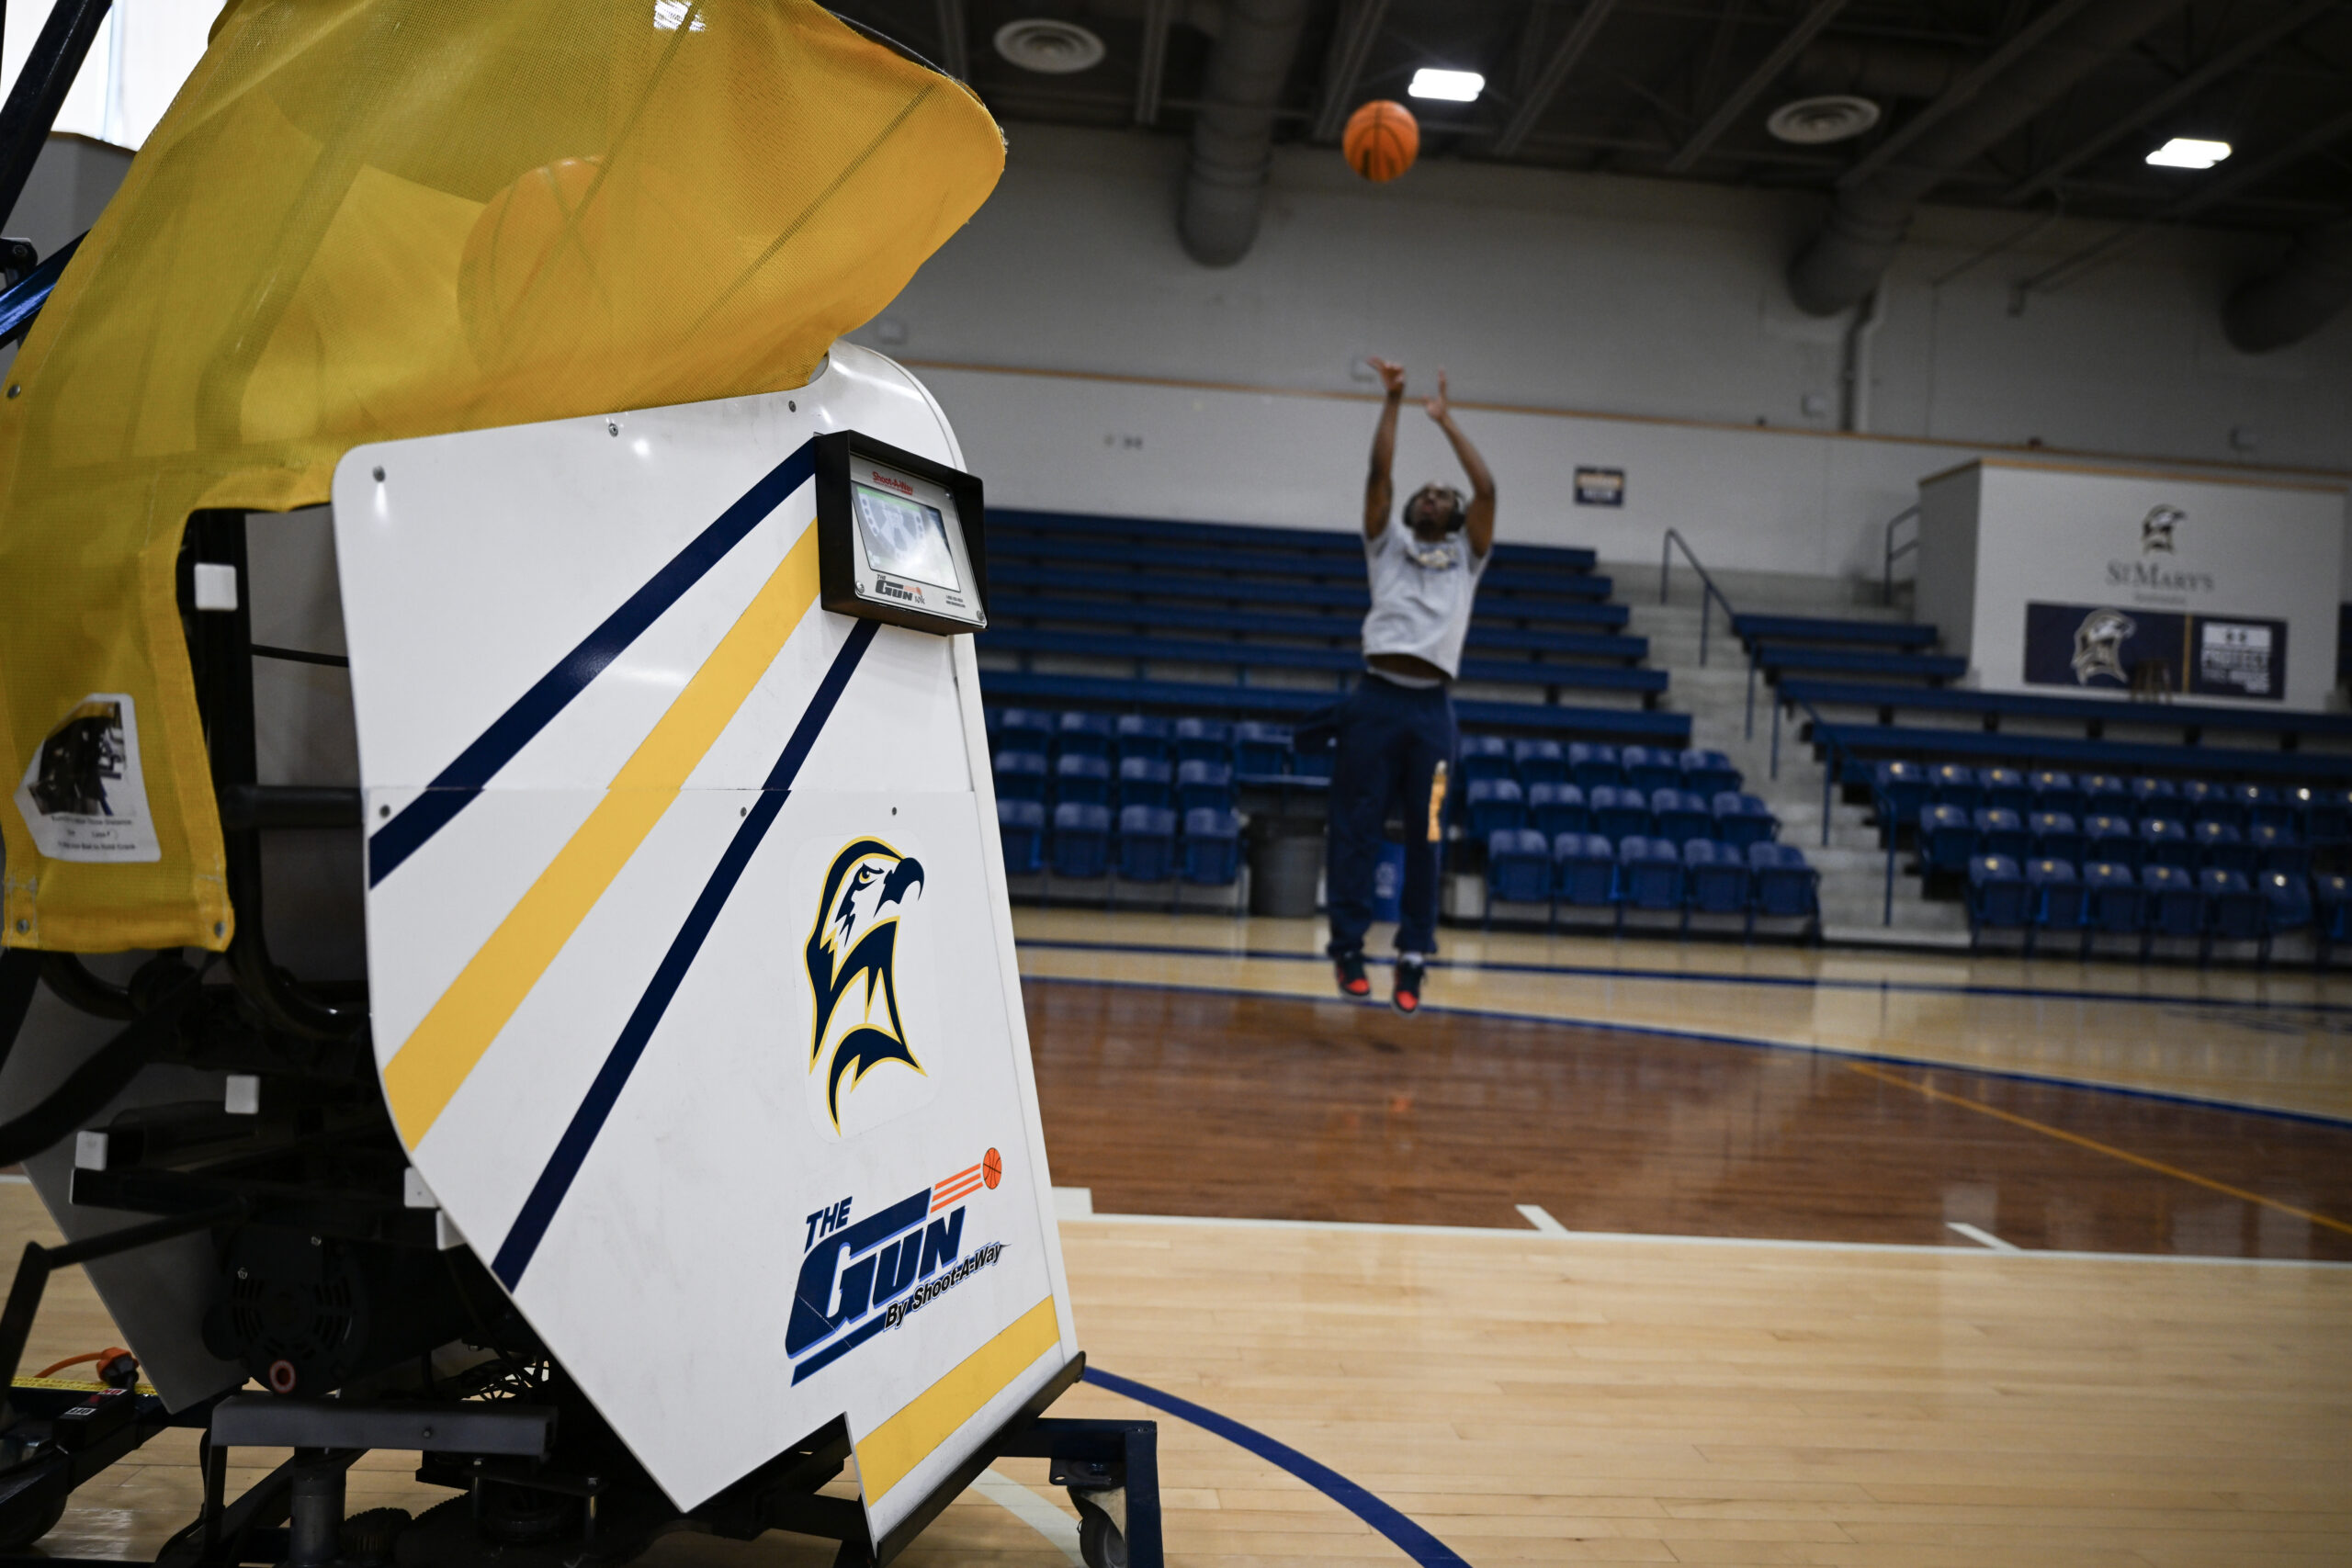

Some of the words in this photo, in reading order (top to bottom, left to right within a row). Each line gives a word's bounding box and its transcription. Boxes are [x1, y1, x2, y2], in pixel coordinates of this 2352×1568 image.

[876, 580, 913, 602] GUN
[804, 1196, 853, 1255] THE
[786, 1187, 966, 1359] GUN
[885, 1301, 908, 1328] By
[912, 1243, 1005, 1310] Shoot-A-Way
